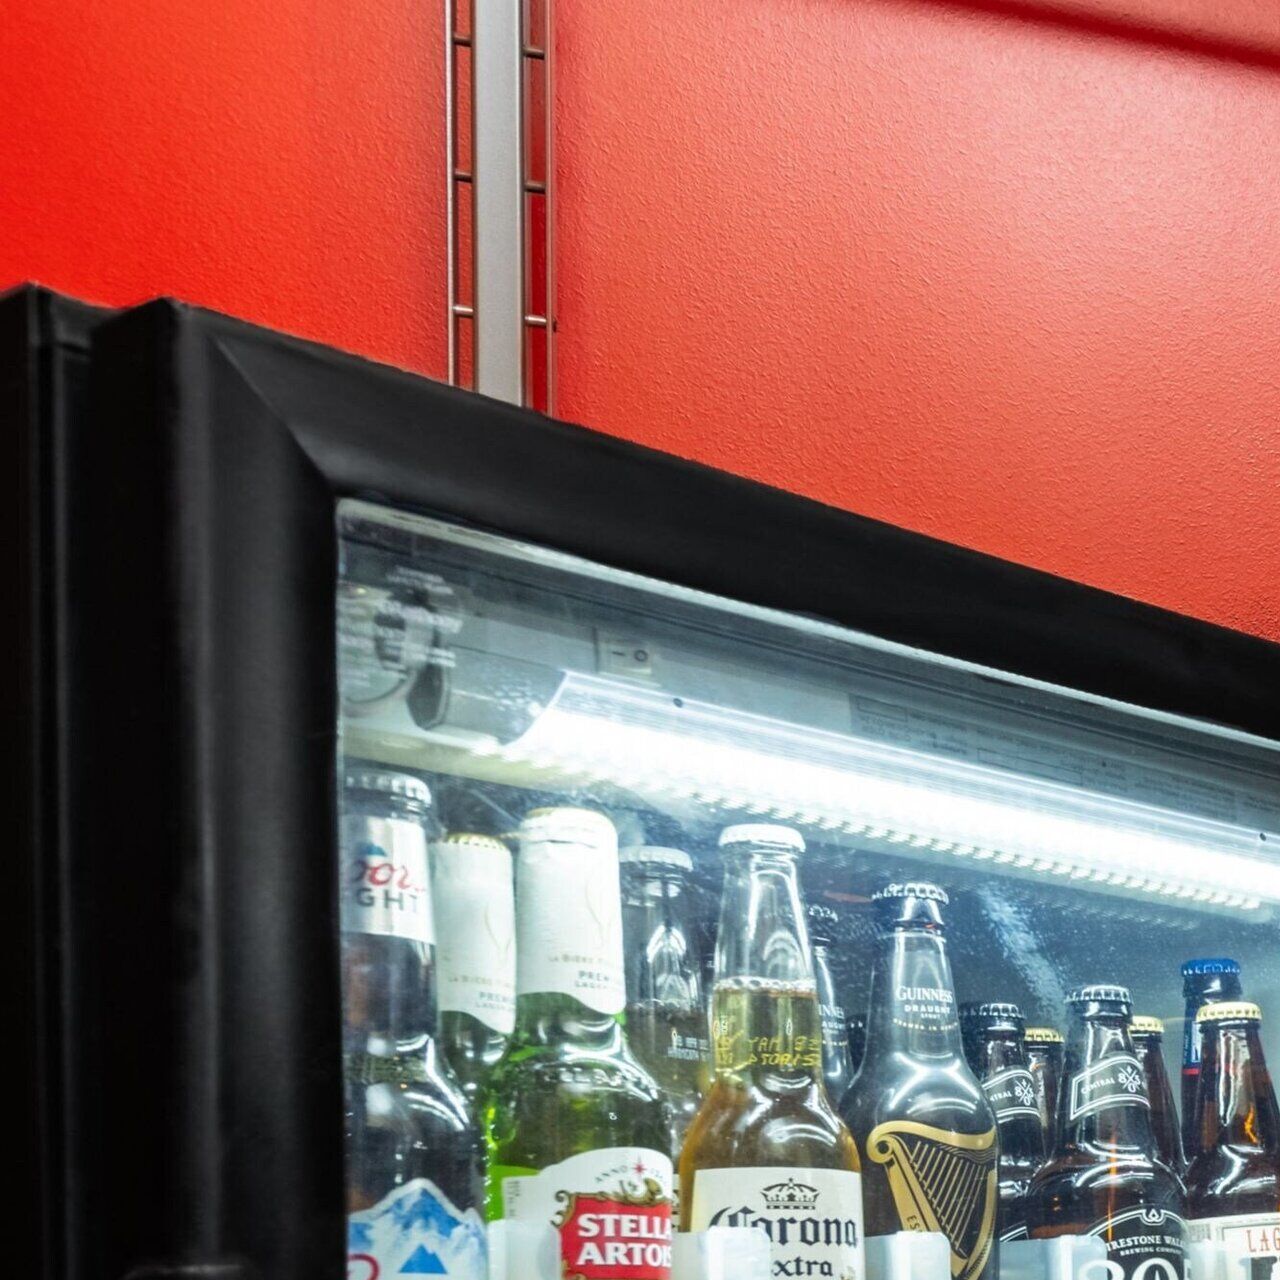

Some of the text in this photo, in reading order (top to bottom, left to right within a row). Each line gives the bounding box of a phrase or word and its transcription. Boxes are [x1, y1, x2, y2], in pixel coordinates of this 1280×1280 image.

[896, 987, 953, 1002] GUINNESS
[578, 1215, 671, 1239] STELLA
[1106, 1235, 1161, 1251] IRESTONE
[577, 1243, 671, 1266] ARTOIS
[772, 1256, 833, 1276] xtra
